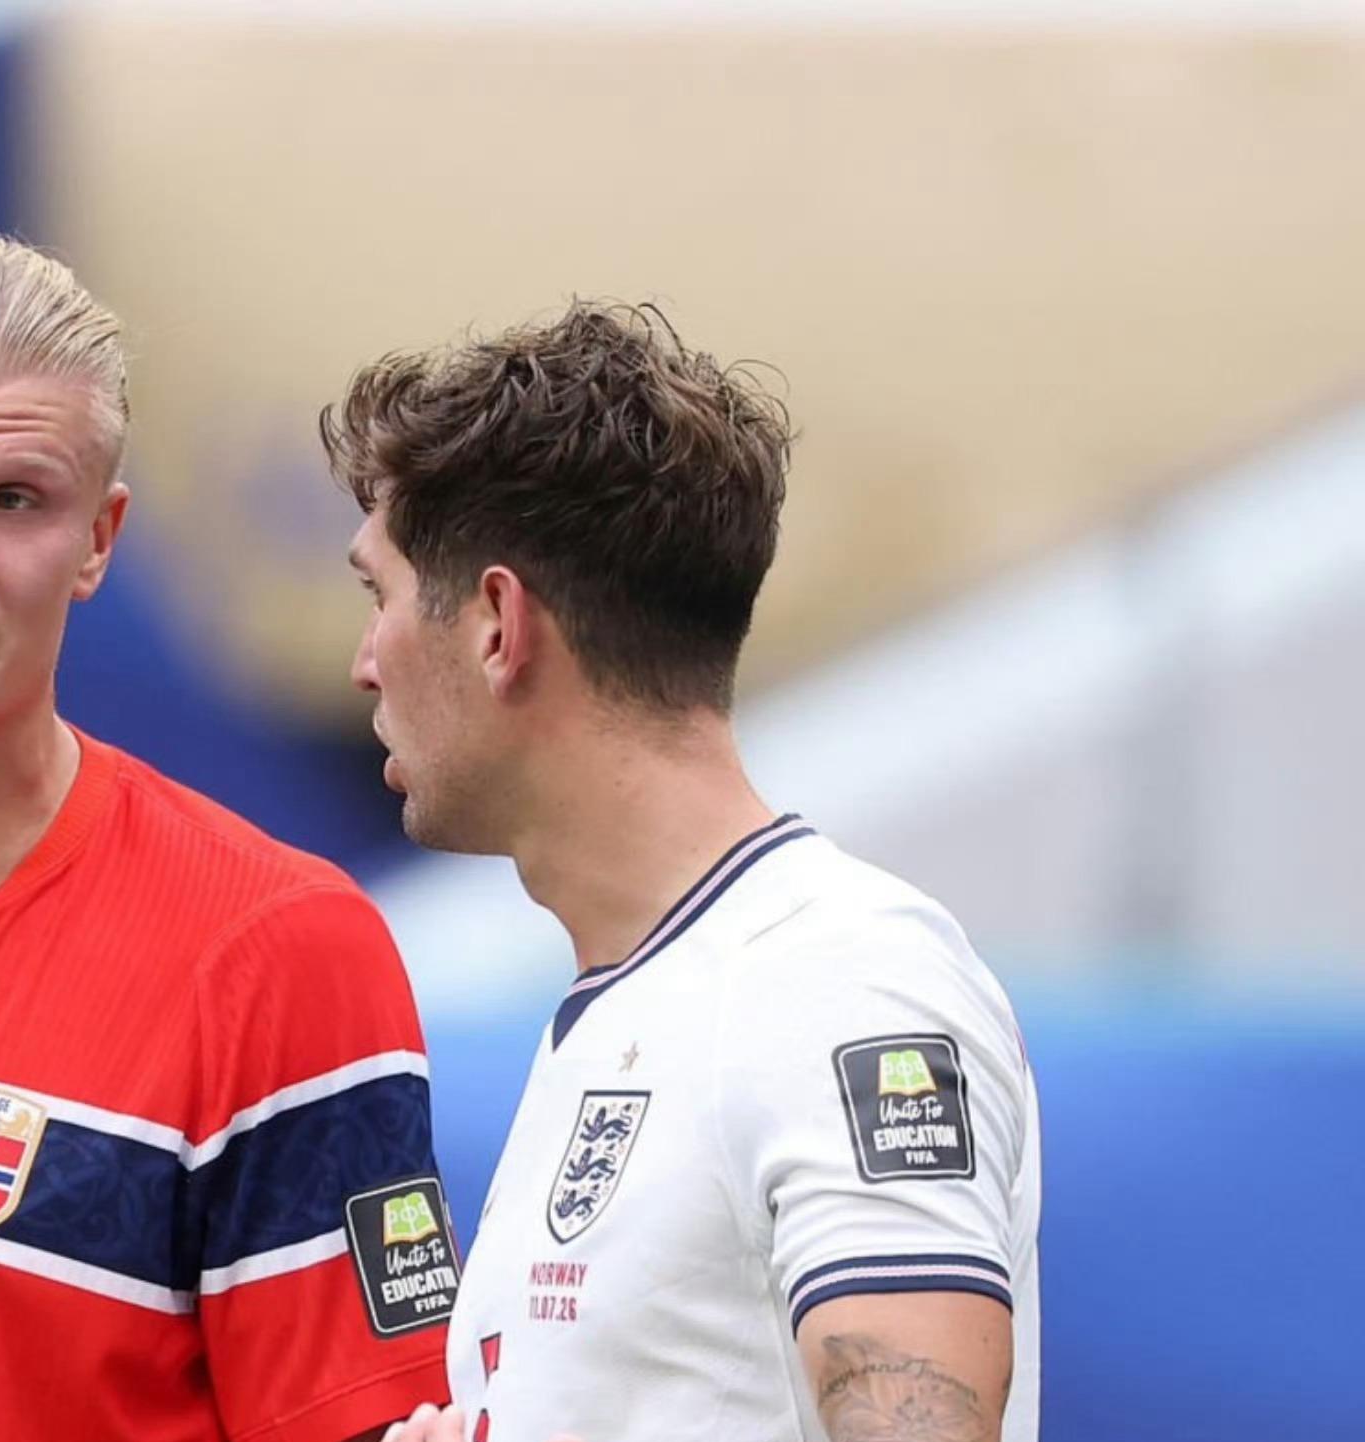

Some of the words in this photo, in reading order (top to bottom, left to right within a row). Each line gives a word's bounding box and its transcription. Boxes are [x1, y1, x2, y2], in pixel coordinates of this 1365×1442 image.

[879, 1096, 921, 1125] Unite
[920, 1096, 944, 1122] For
[873, 1124, 959, 1153] EDUCATION
[529, 1262, 589, 1287] NORWAY
[529, 1296, 578, 1322] 11.07.26
